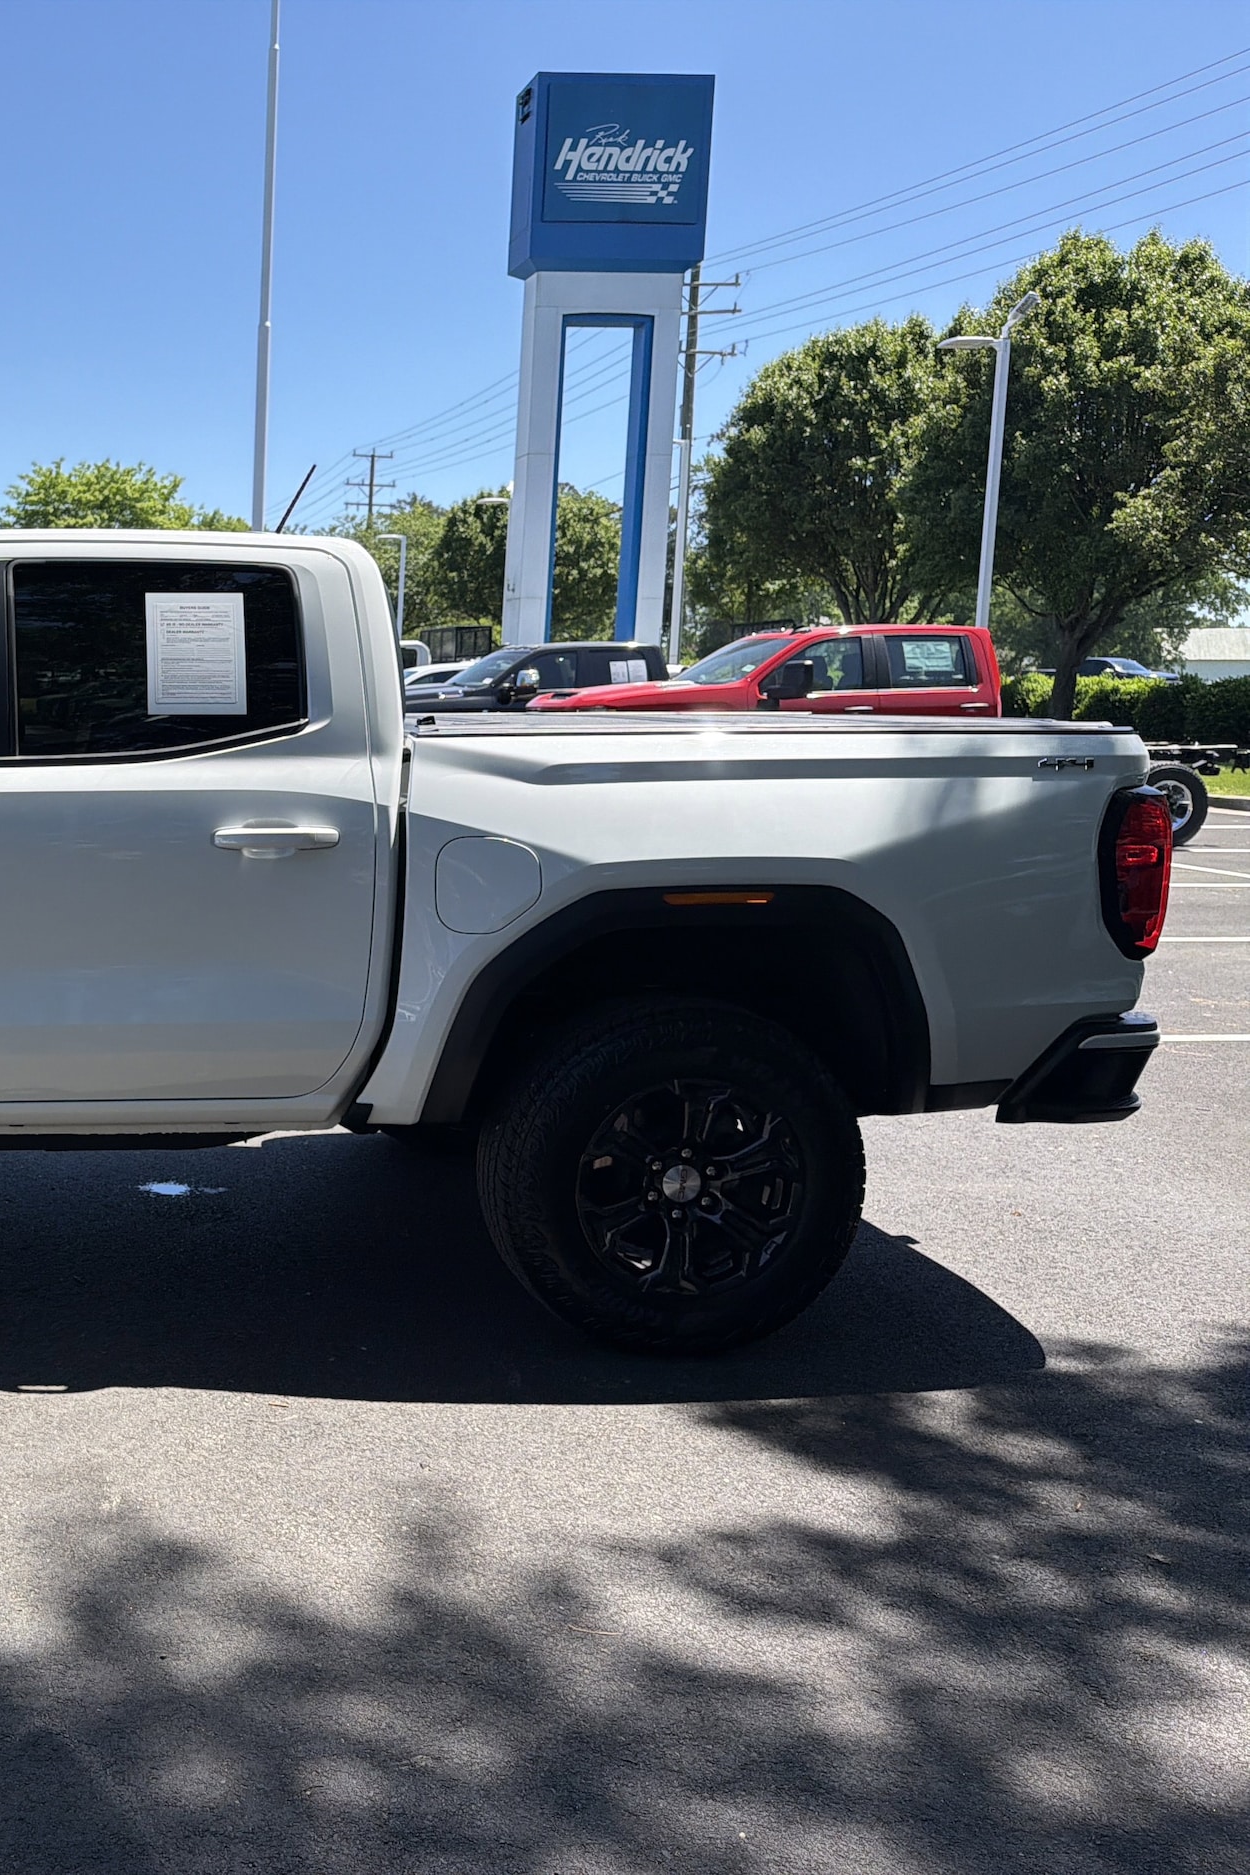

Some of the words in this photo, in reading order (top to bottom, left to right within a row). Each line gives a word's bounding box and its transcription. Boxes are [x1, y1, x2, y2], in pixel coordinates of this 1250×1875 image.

[553, 138, 694, 180] Hendrick
[576, 172, 630, 182] CHEVROLET
[631, 173, 658, 182] BUICK
[660, 174, 683, 183] GMC
